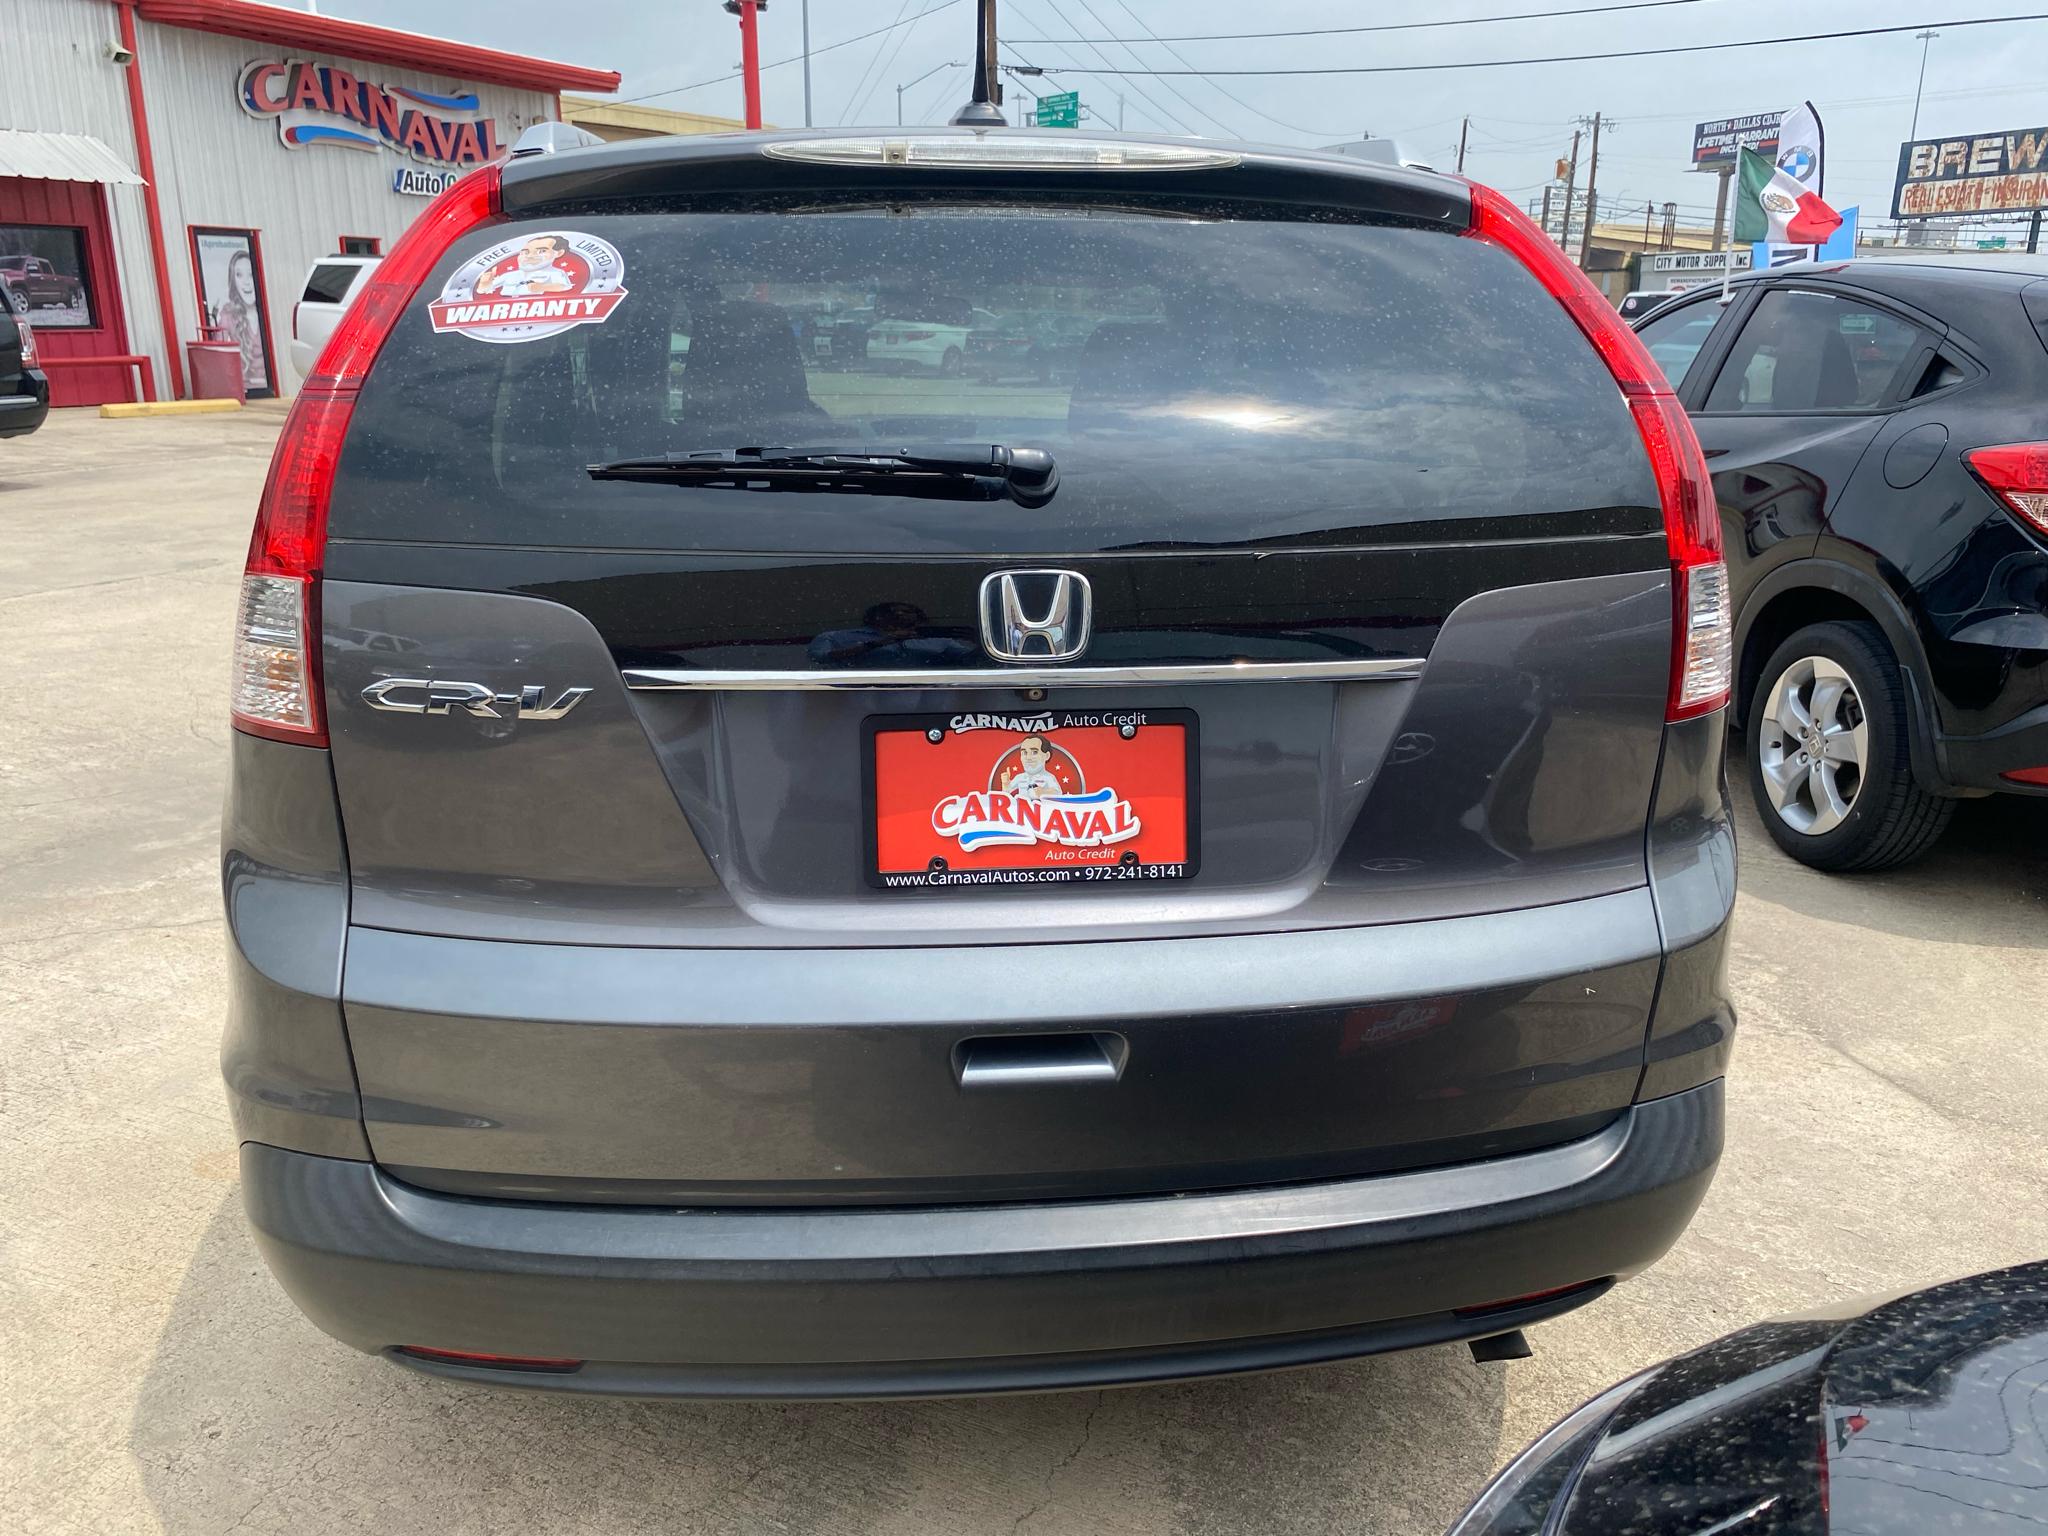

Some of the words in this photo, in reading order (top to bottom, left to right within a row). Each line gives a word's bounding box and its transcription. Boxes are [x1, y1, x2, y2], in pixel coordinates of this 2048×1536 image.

[251, 63, 507, 162] CARNAVAL
[1703, 121, 1728, 135] NORTH
[1733, 116, 1761, 130] DALLAS
[1697, 132, 1736, 149] LIFETIME
[1735, 127, 1780, 143] WARRANT
[1720, 141, 1760, 154] INCLED!
[1908, 130, 2048, 179] BREW
[403, 170, 440, 194] Auto
[1903, 184, 1934, 210] REAL
[1936, 180, 1985, 208] ESTAT
[477, 245, 509, 267] FREE
[576, 240, 612, 267] LIMITED
[1656, 257, 1672, 269] CITY
[1675, 256, 1699, 268] MOTOR
[1703, 254, 1728, 267] SUPPL
[446, 298, 602, 324] WARRANTY
[361, 678, 594, 720] CR-V
[950, 713, 1058, 733] CARNAVAL
[1063, 714, 1099, 726] Auto
[1103, 712, 1147, 725] Credit
[933, 793, 1136, 839] CARNAVAL
[1045, 850, 1075, 861] Auto
[1078, 849, 1115, 860] Credit
[886, 869, 1070, 887] www.CarnavalAutos.com
[1085, 865, 1183, 880] 972-241-8141
